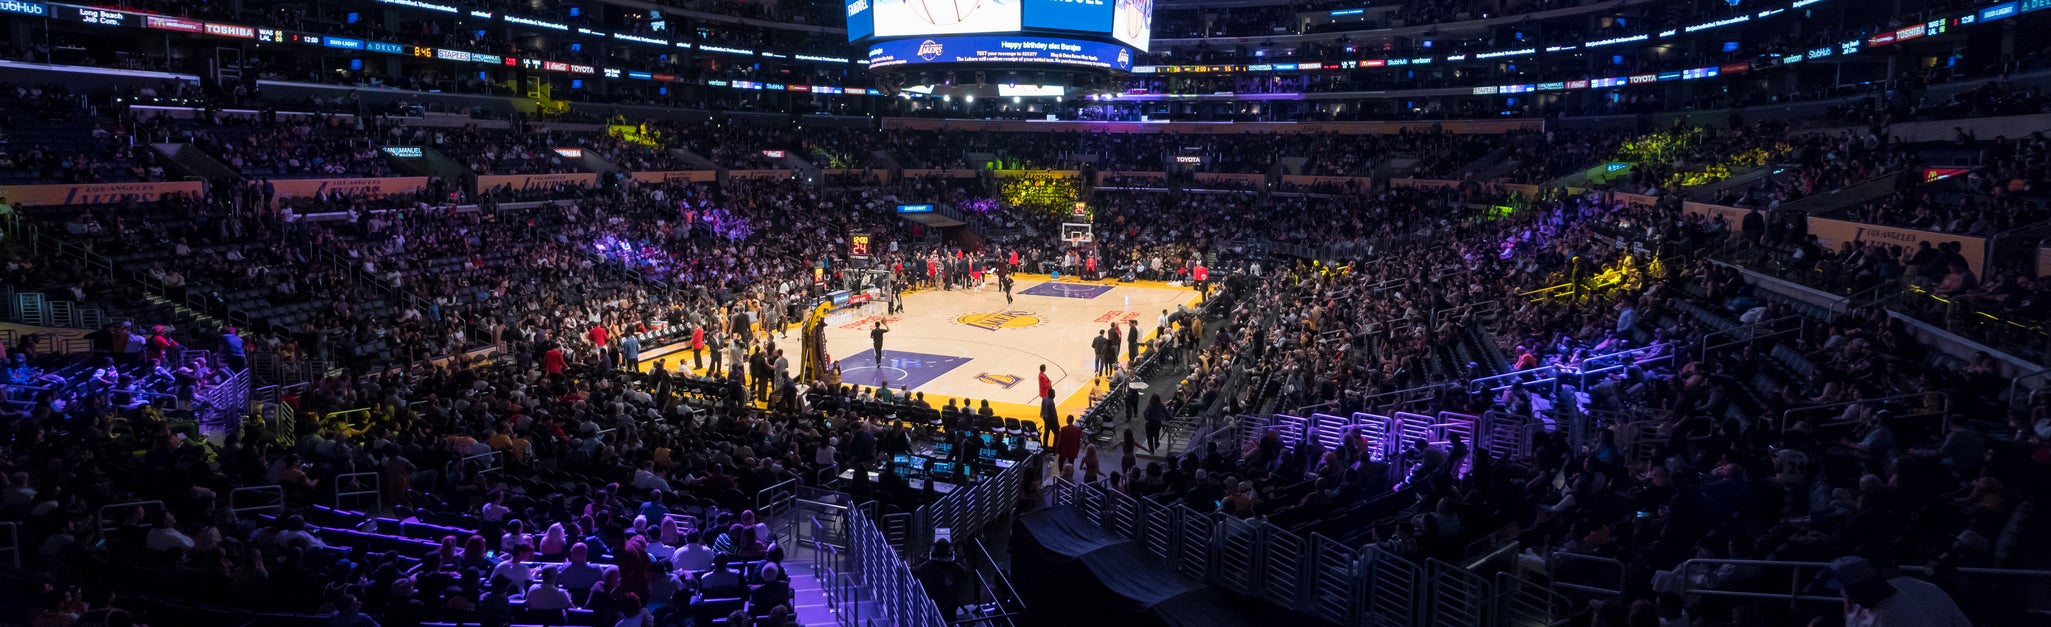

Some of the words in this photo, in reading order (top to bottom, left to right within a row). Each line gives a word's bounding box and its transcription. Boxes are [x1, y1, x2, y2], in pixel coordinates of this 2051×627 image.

[80, 9, 98, 17] Long
[100, 11, 123, 19] Beach
[205, 24, 253, 37] TOSHIBA
[1896, 25, 1925, 40] TOSHIBA
[375, 42, 401, 52] DELTA
[1001, 41, 1022, 49] Happy
[1023, 42, 1047, 50] birthday
[415, 46, 431, 57] 8:46
[439, 49, 469, 60] STAPLES
[1808, 48, 1831, 58] StubHub
[570, 65, 594, 74] TOYOTA
[1629, 75, 1656, 84] TOYOTA
[1882, 232, 1916, 241] ANGELES
[853, 244, 867, 254] 24
